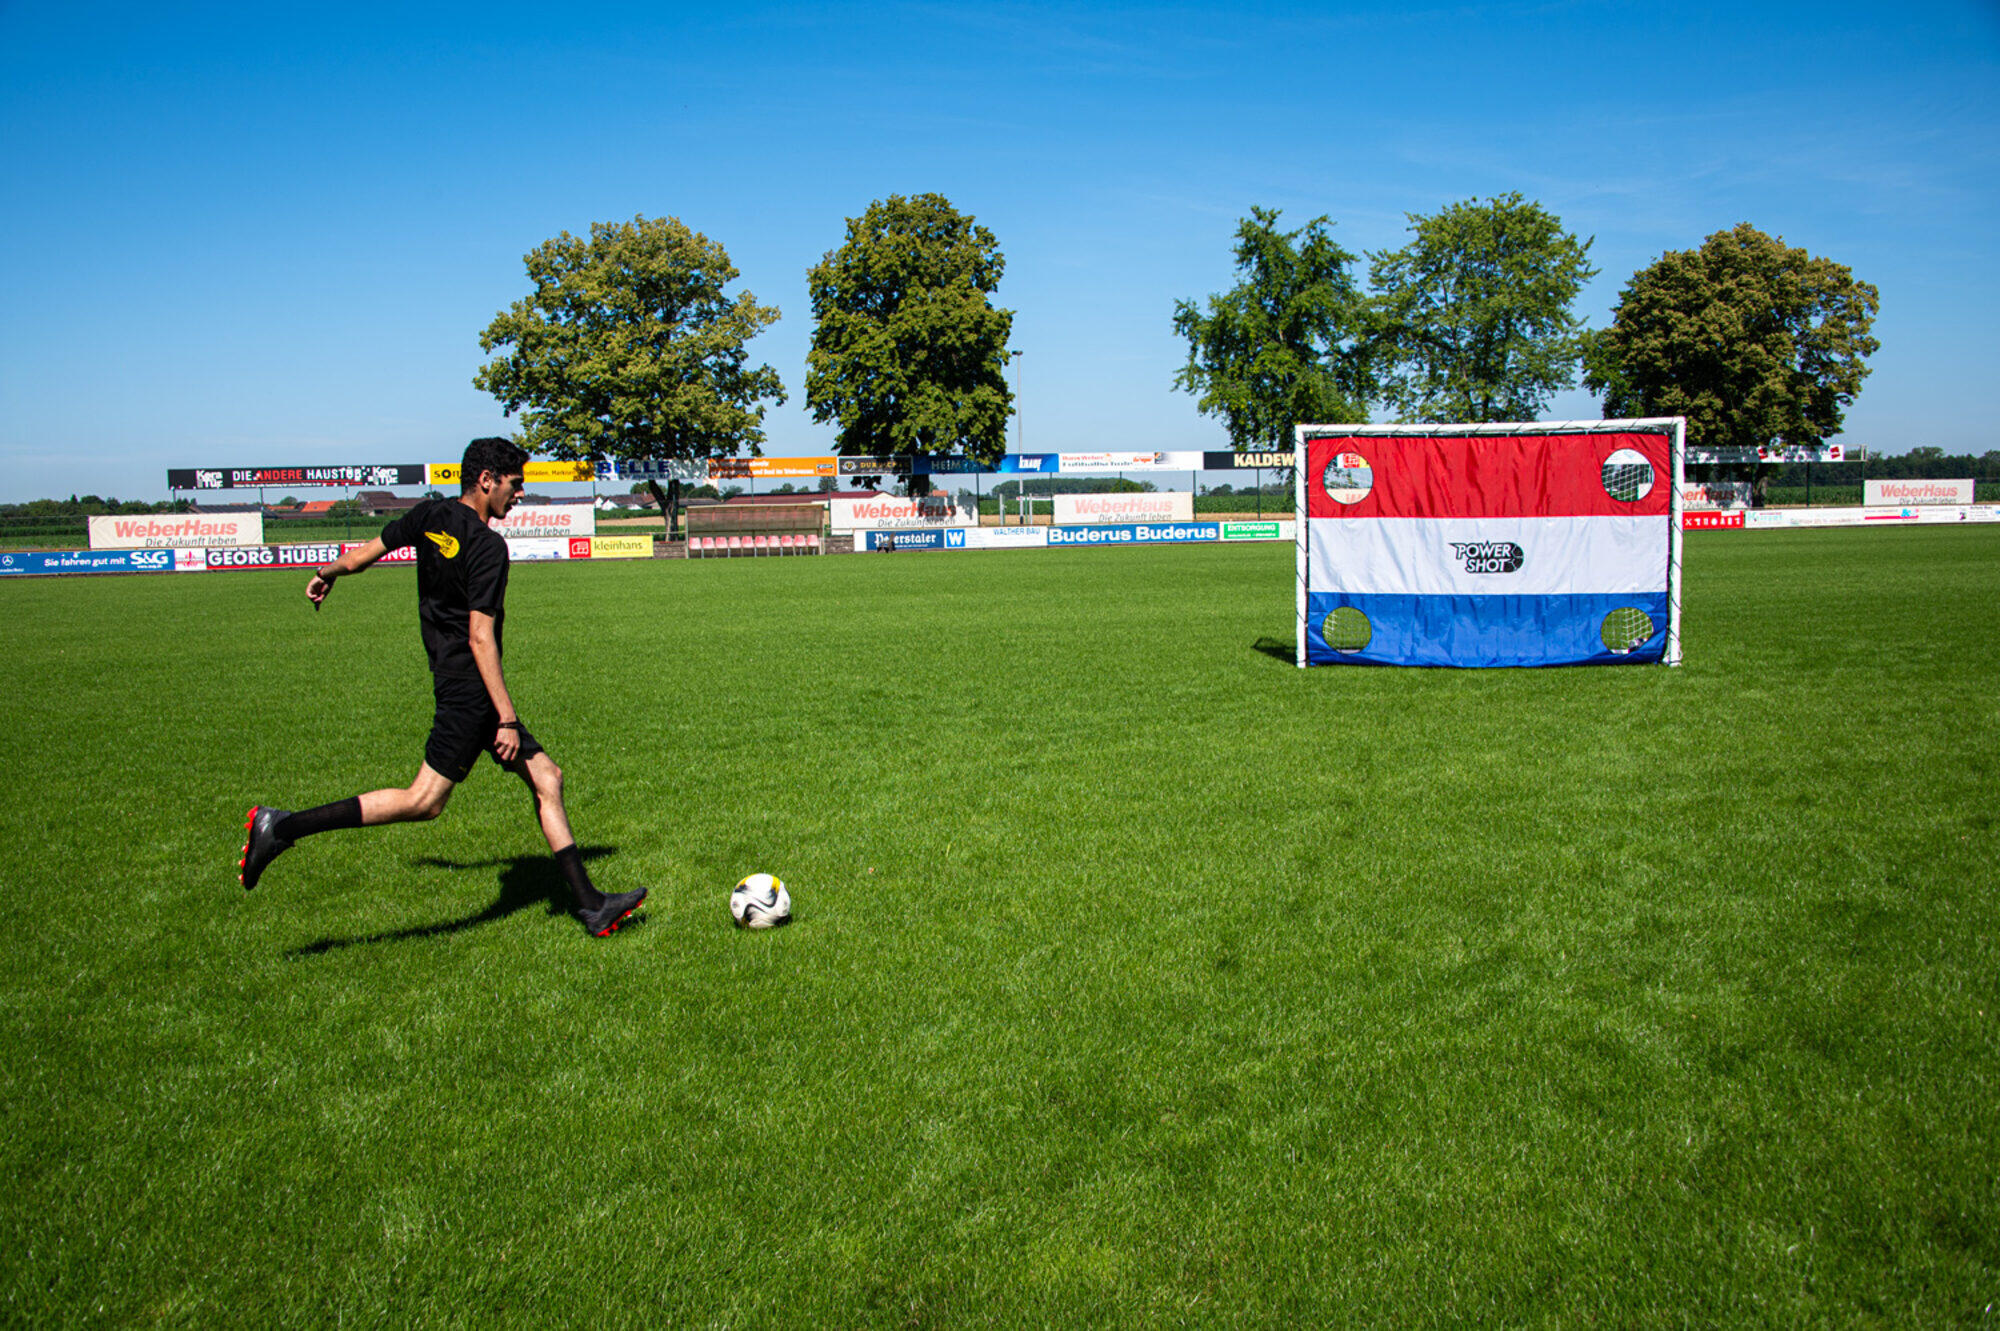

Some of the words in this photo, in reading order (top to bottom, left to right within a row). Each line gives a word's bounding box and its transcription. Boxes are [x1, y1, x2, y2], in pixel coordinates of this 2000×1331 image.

[1234, 453, 1296, 468] KALDEW
[233, 470, 252, 482] DIE
[257, 469, 302, 481] ANDERE
[1881, 484, 1958, 498] WeberHaus
[853, 502, 957, 519] WeberHaus
[1074, 498, 1174, 514] WeberHaus
[1098, 513, 1113, 522] Die
[1148, 510, 1173, 520] leben
[114, 519, 240, 538] WeberHaus
[878, 519, 893, 528] Die
[504, 527, 541, 538] Zukunft
[543, 526, 571, 537] leben
[1050, 528, 1132, 543] Buderus
[1135, 525, 1217, 541] Buderus
[145, 538, 162, 547] Die
[165, 536, 206, 547] Zukunft
[208, 535, 238, 546] leben
[593, 540, 644, 552] kleinhans
[874, 533, 937, 546] Peerstaler
[130, 551, 169, 566] S&G
[207, 551, 274, 566] GEORG
[279, 548, 340, 563] HUBER
[1454, 543, 1512, 560] POWER
[44, 558, 59, 567] Sie
[61, 557, 91, 567] fahren
[92, 556, 110, 568] gut
[110, 556, 126, 566] mit
[1467, 558, 1511, 573] SHOT
